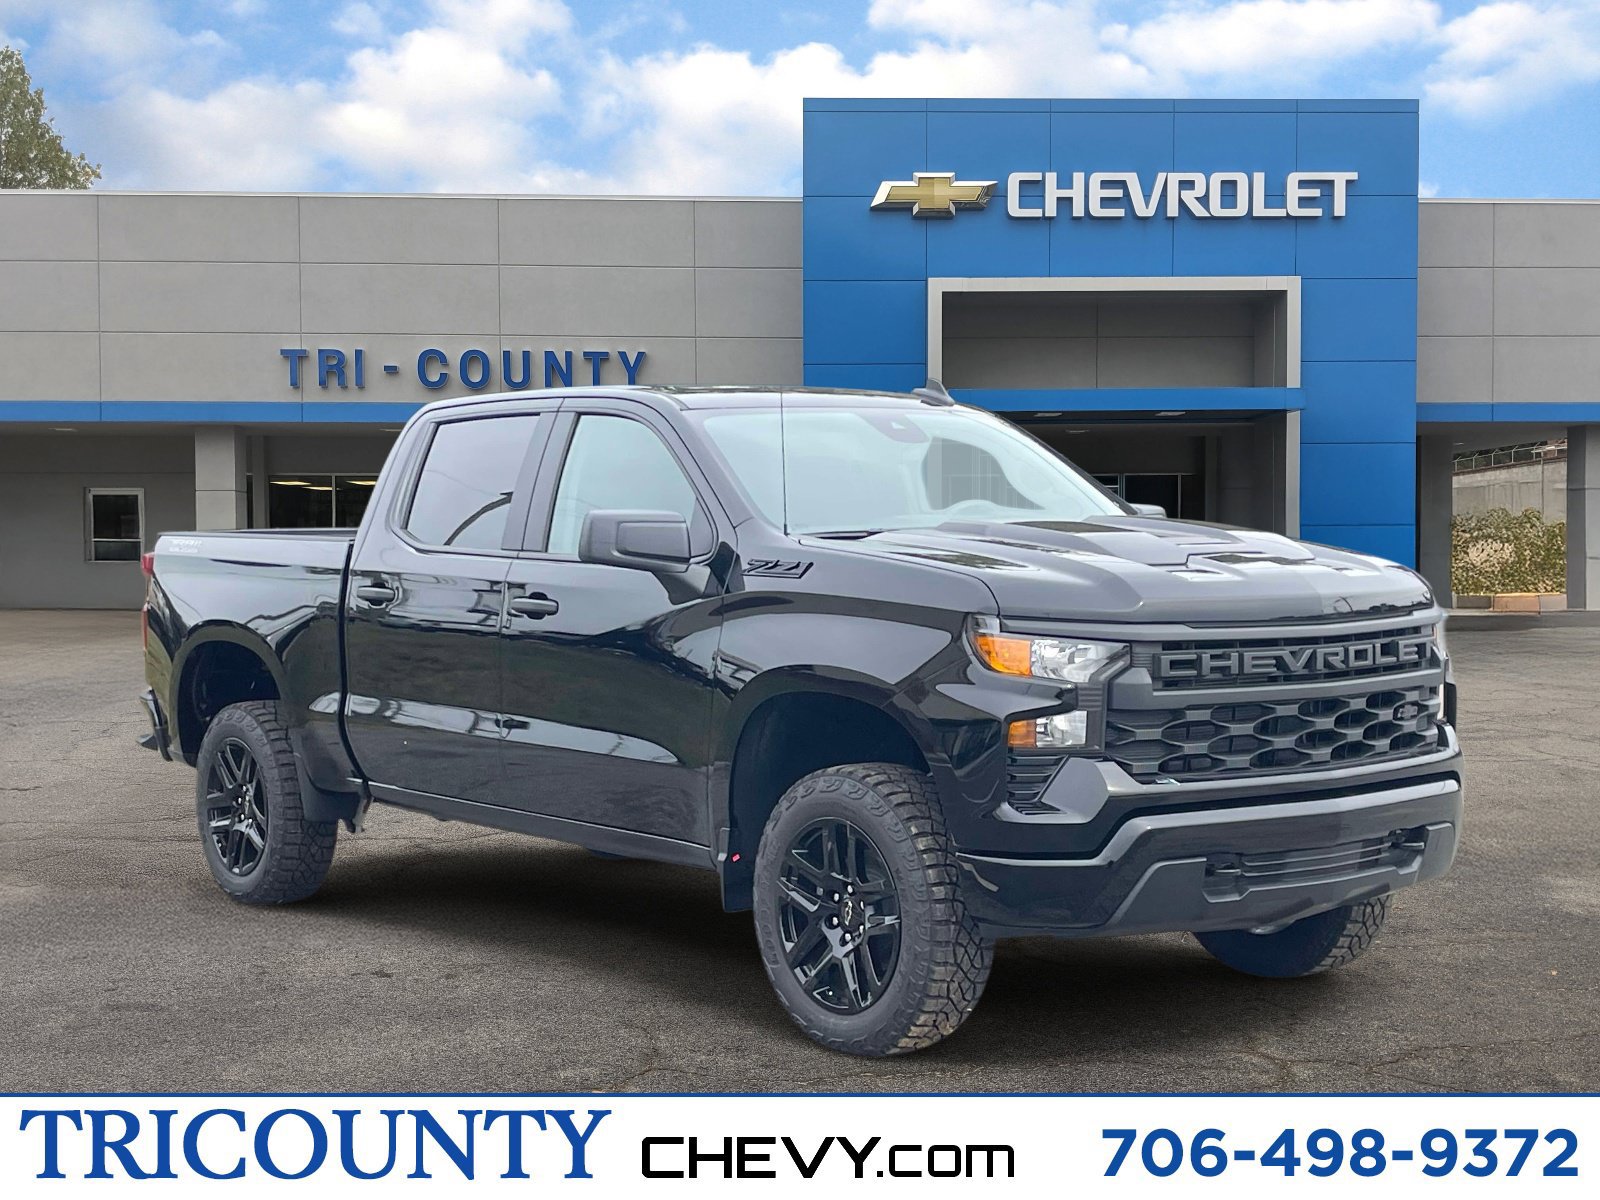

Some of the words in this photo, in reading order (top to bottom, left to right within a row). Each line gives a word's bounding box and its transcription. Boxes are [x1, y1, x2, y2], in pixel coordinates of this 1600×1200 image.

[1007, 171, 1359, 218] CHEVROLET
[741, 558, 814, 579] Z71
[1154, 638, 1435, 679] CHEVROLET
